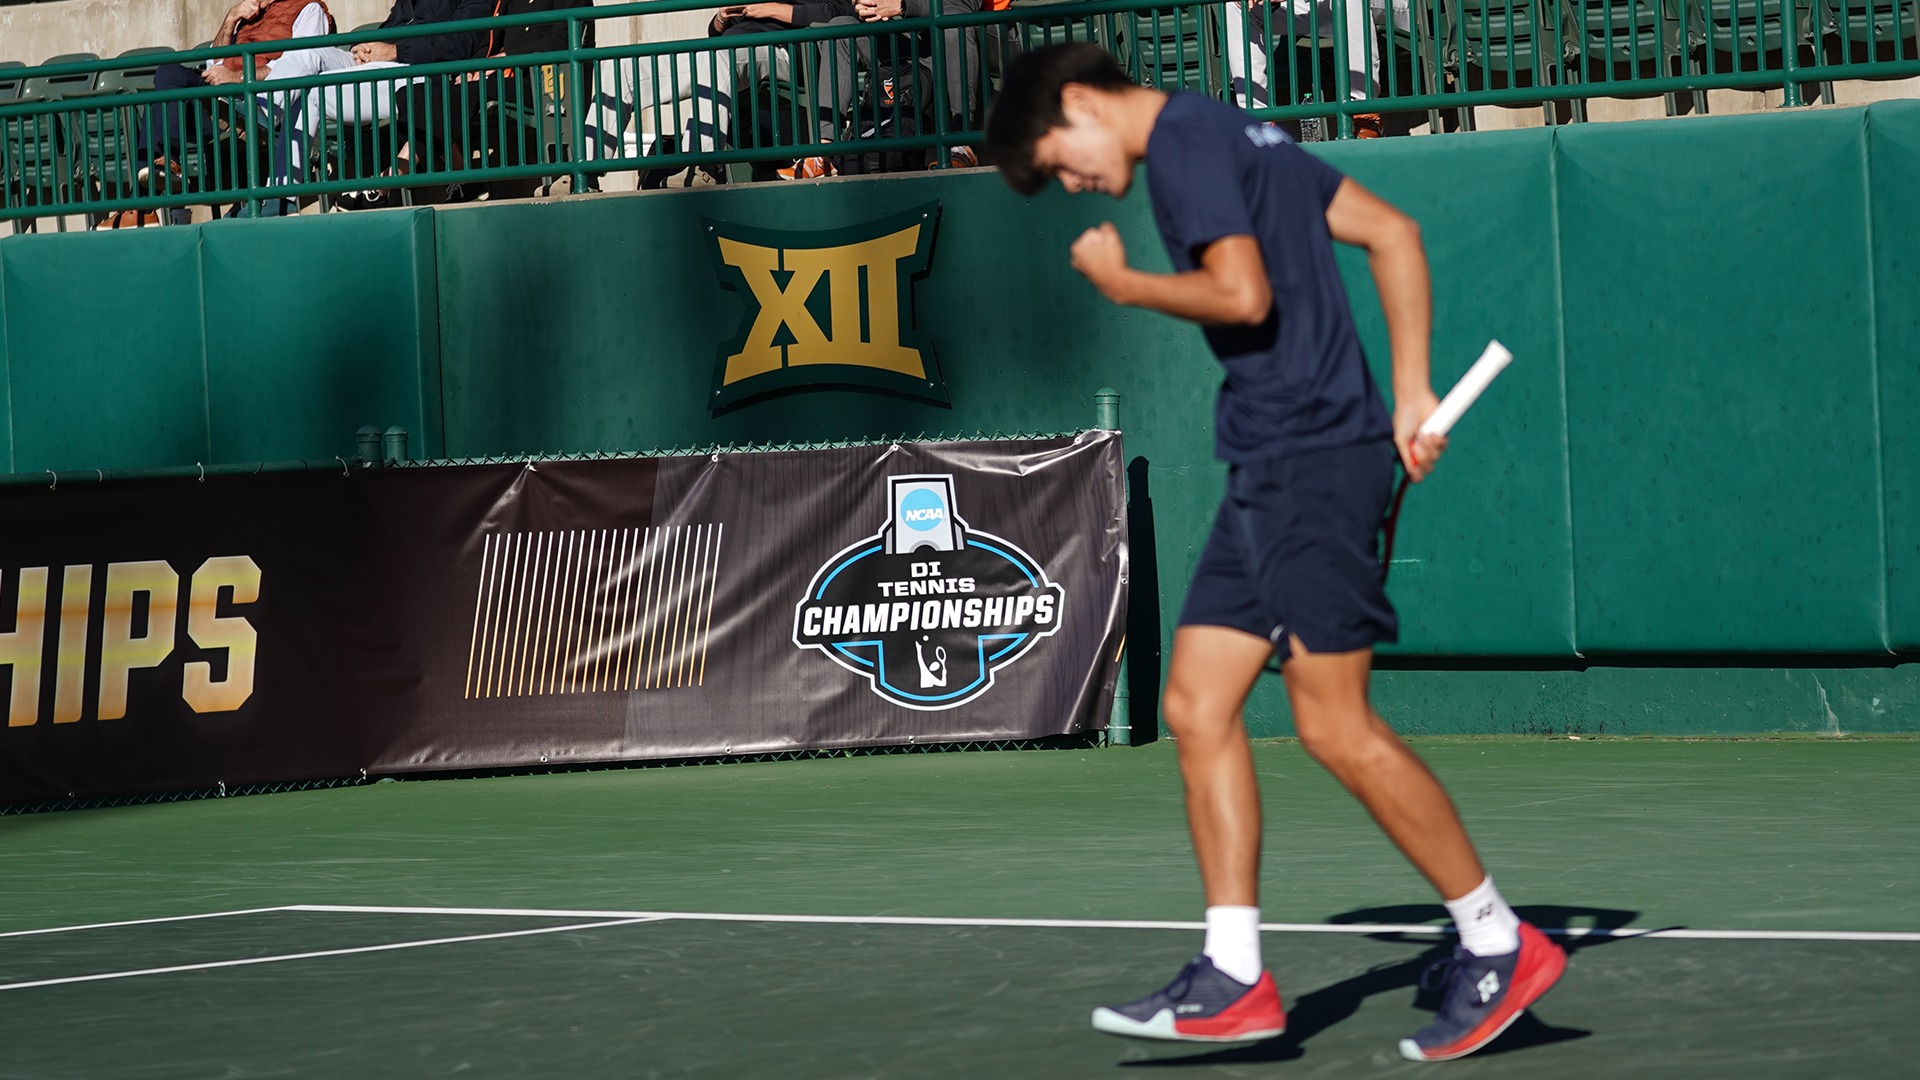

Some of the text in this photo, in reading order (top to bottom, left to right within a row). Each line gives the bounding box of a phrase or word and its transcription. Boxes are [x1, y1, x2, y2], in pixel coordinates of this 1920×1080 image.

[717, 223, 927, 386] XII
[905, 508, 944, 522] NCAA
[910, 561, 942, 578] DI
[878, 577, 976, 597] TENNIS
[803, 594, 1055, 637] CHAMPIONSHIPS
